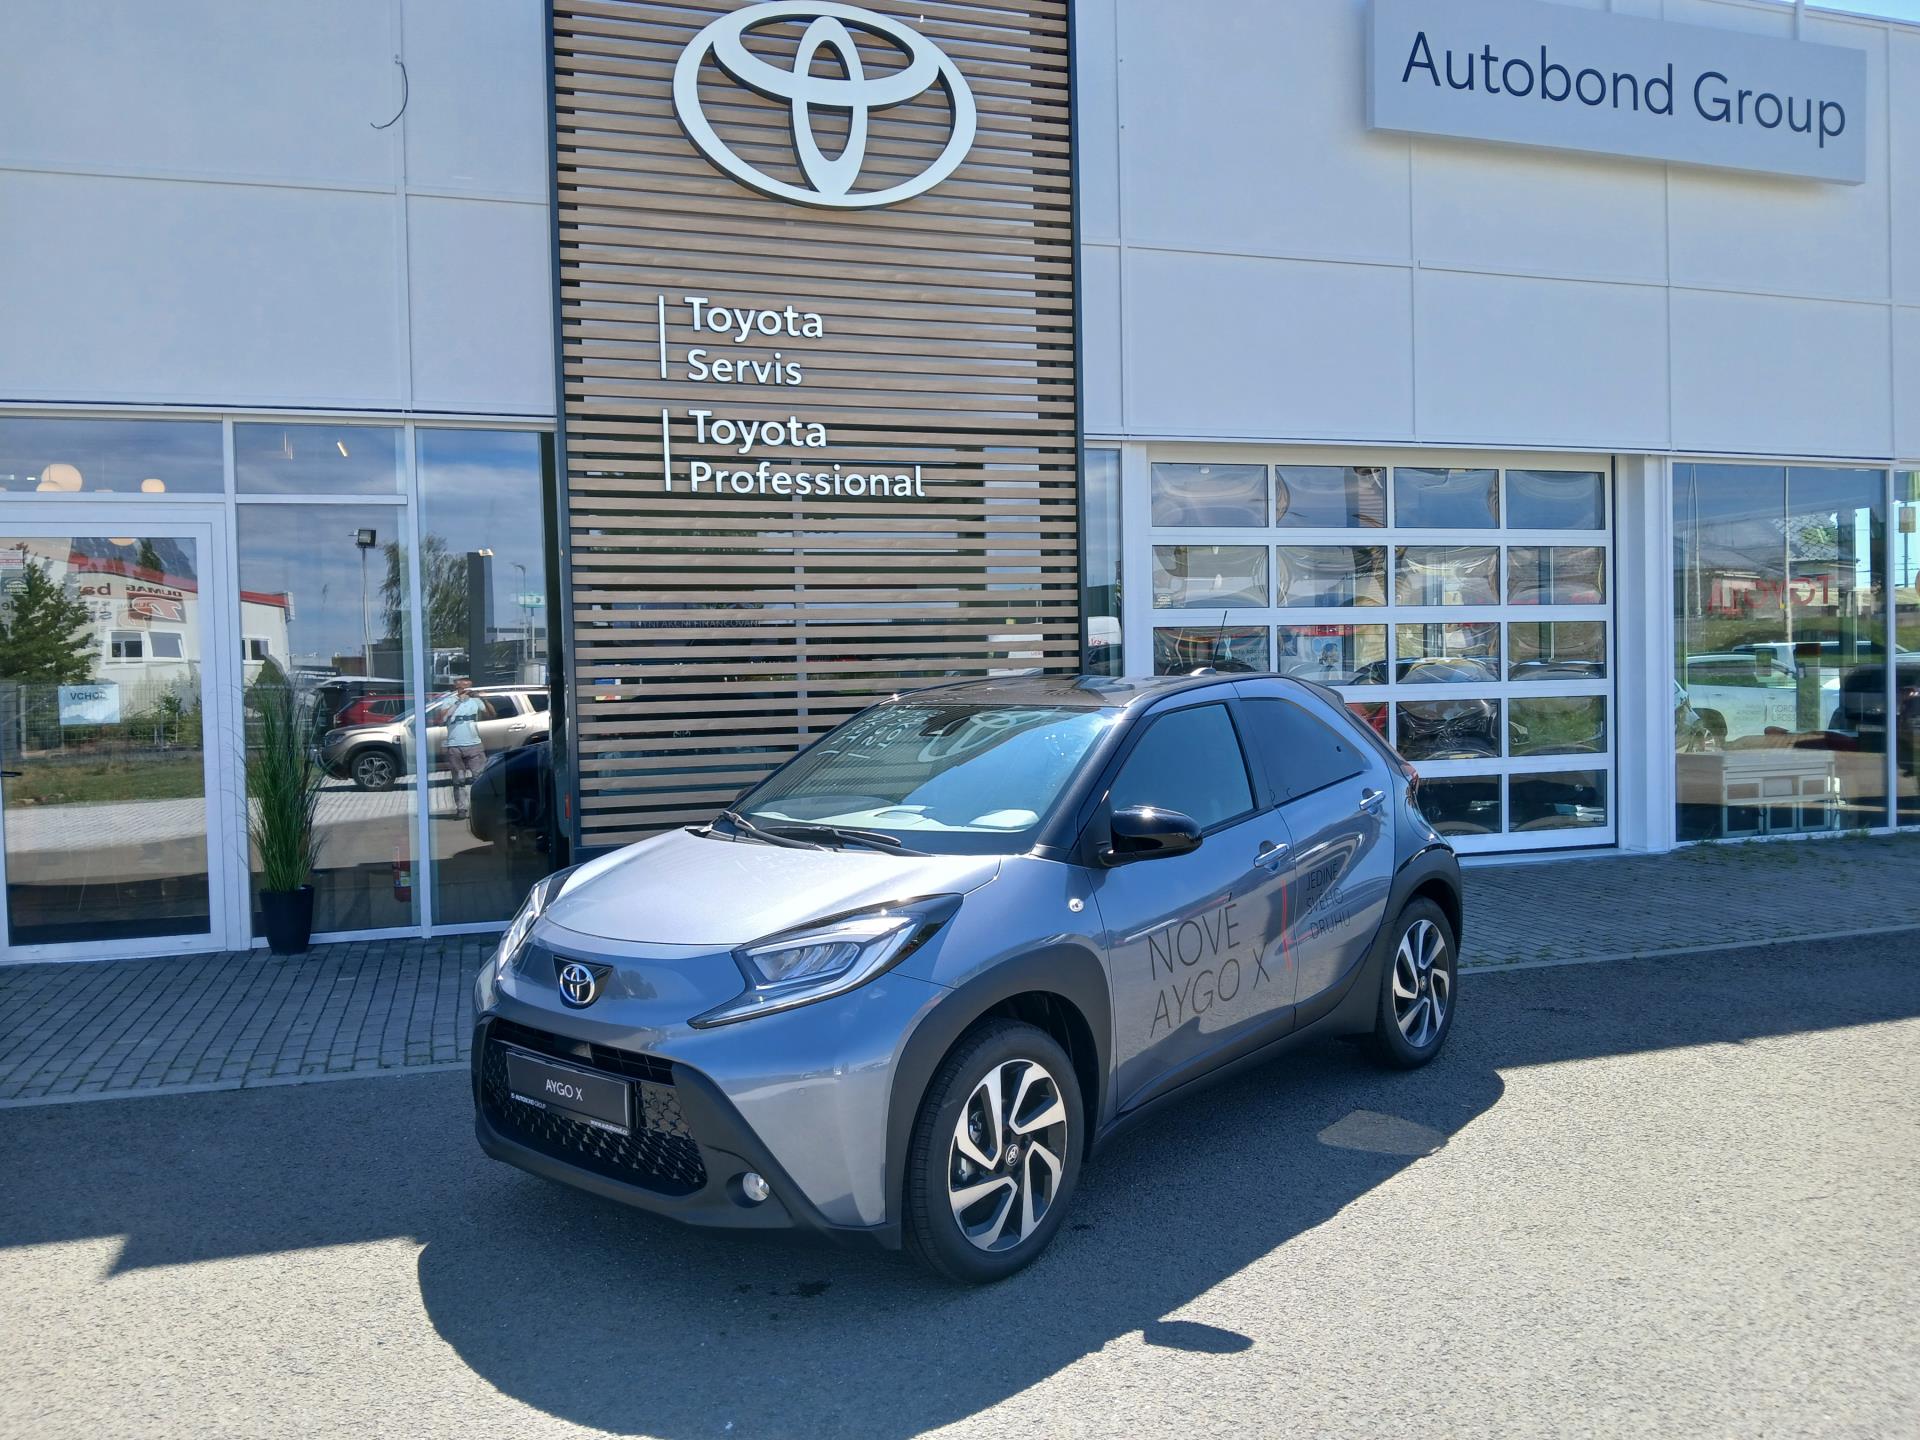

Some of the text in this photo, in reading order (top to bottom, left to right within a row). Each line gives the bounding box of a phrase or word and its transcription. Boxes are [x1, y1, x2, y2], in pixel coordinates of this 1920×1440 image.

[1402, 31, 1846, 148] Autobond Group
[684, 296, 824, 343] Toyota
[686, 349, 802, 386] Servis
[687, 409, 828, 454] Toyota
[689, 461, 926, 498] Professional
[1147, 891, 1240, 981] NOVÉ
[1150, 942, 1270, 1039] AYGO X
[545, 1078, 584, 1102] AYGO X
